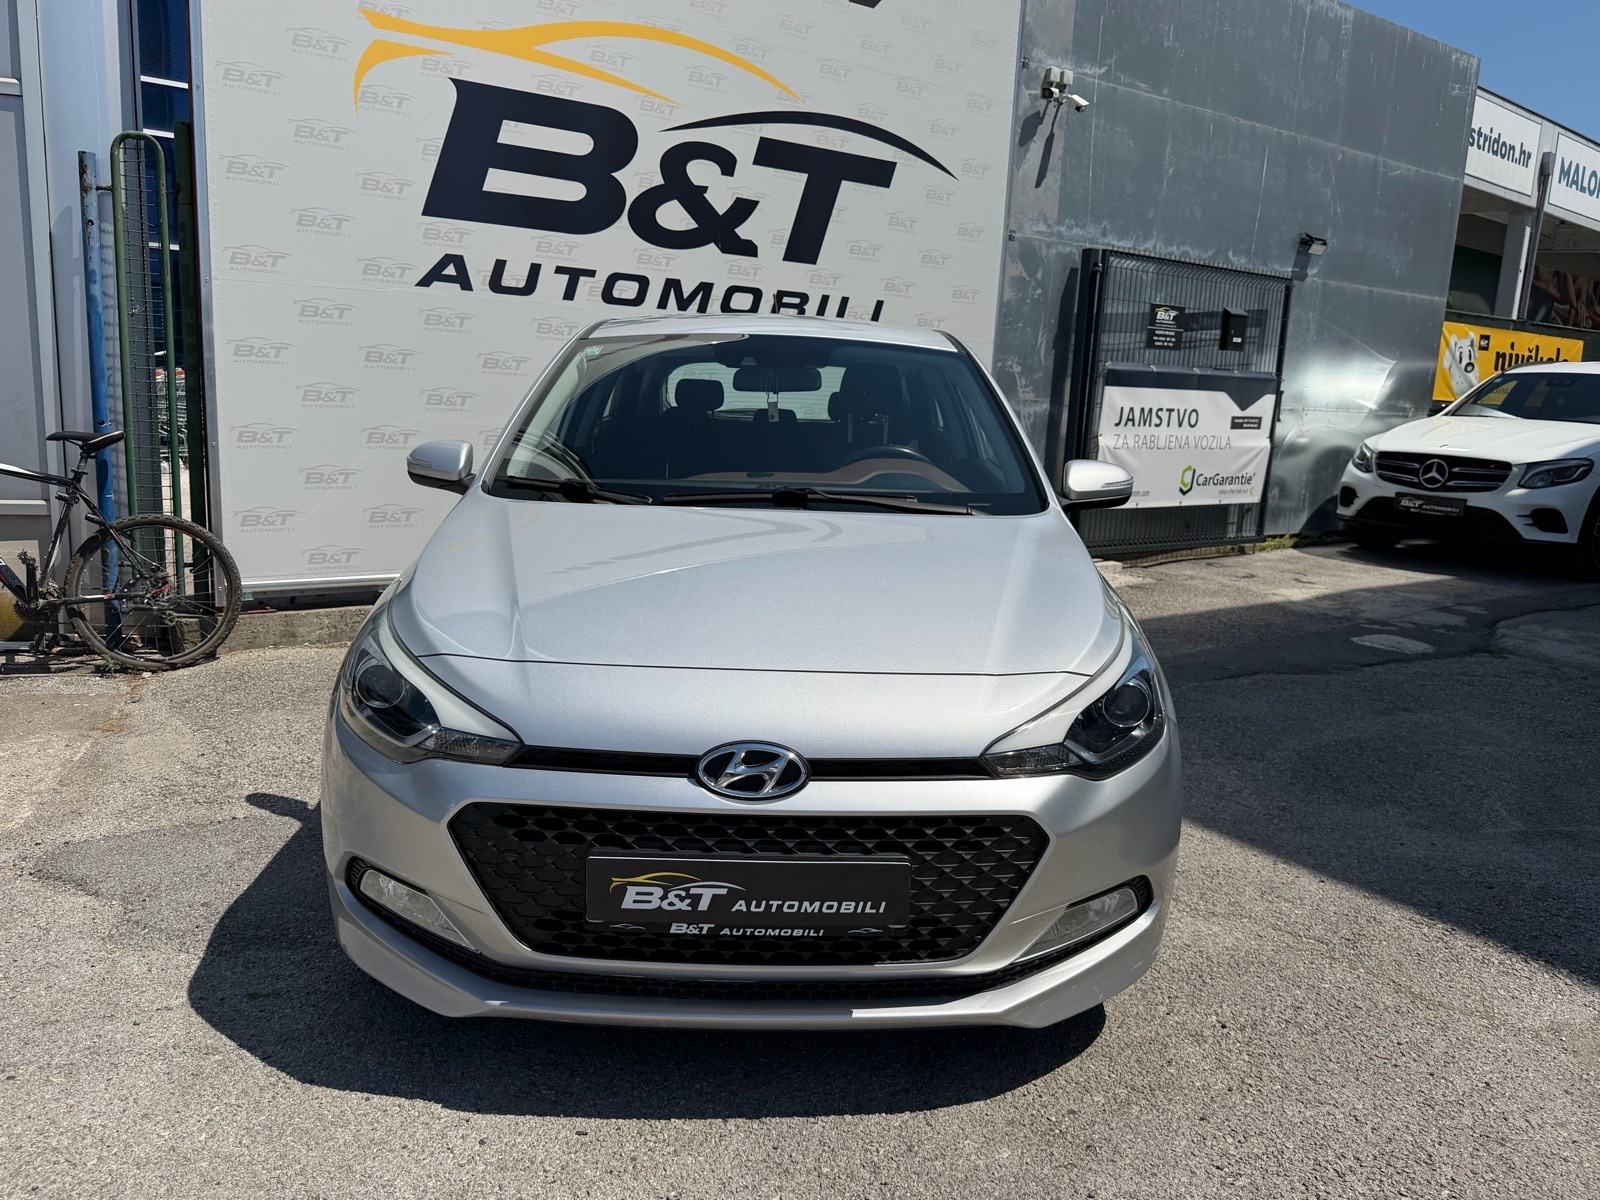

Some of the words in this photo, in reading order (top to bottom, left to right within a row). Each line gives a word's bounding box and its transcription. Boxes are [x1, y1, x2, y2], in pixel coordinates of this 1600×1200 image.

[780, 18, 814, 36] B&T
[291, 33, 346, 53] B&T
[860, 39, 893, 55] B&T
[590, 50, 632, 67] B&T
[735, 43, 770, 59] B&T
[420, 57, 471, 77] B&T
[820, 63, 852, 79] B&T
[222, 66, 281, 88] B&T
[688, 71, 727, 87] B&T
[536, 80, 581, 97] B&T
[897, 81, 926, 96] B&T
[640, 100, 680, 116] B&T
[967, 98, 994, 112] B&T
[293, 124, 349, 143] B&T
[930, 123, 959, 137] B&T
[1469, 126, 1531, 169] stridon.hr
[225, 160, 283, 179] B&T
[421, 77, 897, 264] B&T
[961, 162, 989, 176] B&T
[360, 177, 411, 194] B&T
[926, 189, 954, 203] B&T
[296, 213, 350, 230] B&T
[888, 216, 919, 230] B&T
[422, 228, 471, 244] B&T
[958, 226, 985, 239] B&T
[536, 240, 579, 256] B&T
[849, 244, 881, 257] B&T
[229, 251, 287, 268] B&T
[637, 253, 676, 268] B&T
[921, 254, 950, 266] B&T
[362, 263, 413, 279] B&T
[728, 264, 764, 279] B&T
[809, 273, 842, 287] B&T
[884, 281, 914, 294] B&T
[953, 290, 980, 302] B&T
[299, 304, 352, 320] B&T
[424, 310, 472, 328] B&T
[917, 317, 945, 329] B&T
[232, 344, 289, 359] B&T
[364, 350, 414, 365] B&T
[1494, 341, 1569, 372] njuškl
[482, 358, 527, 371] B&T
[301, 389, 354, 403] B&T
[425, 394, 472, 407] B&T
[1114, 406, 1199, 429] JAMSTVO
[236, 430, 291, 444] B&T
[366, 432, 416, 445] B&T
[1113, 433, 1129, 450] ZA
[1134, 434, 1190, 450] RABLJENA
[1193, 434, 1231, 450] VOZILA
[304, 471, 357, 485] B&T
[1196, 472, 1252, 487] CarGarantie
[240, 513, 295, 527] B&T
[368, 510, 418, 523] B&T
[307, 551, 359, 565] B&T
[621, 885, 728, 912] B&T
[731, 900, 886, 914] AUTOMOBILI
[669, 922, 715, 935] B&T
[720, 927, 824, 937] AUTOMOBILI
